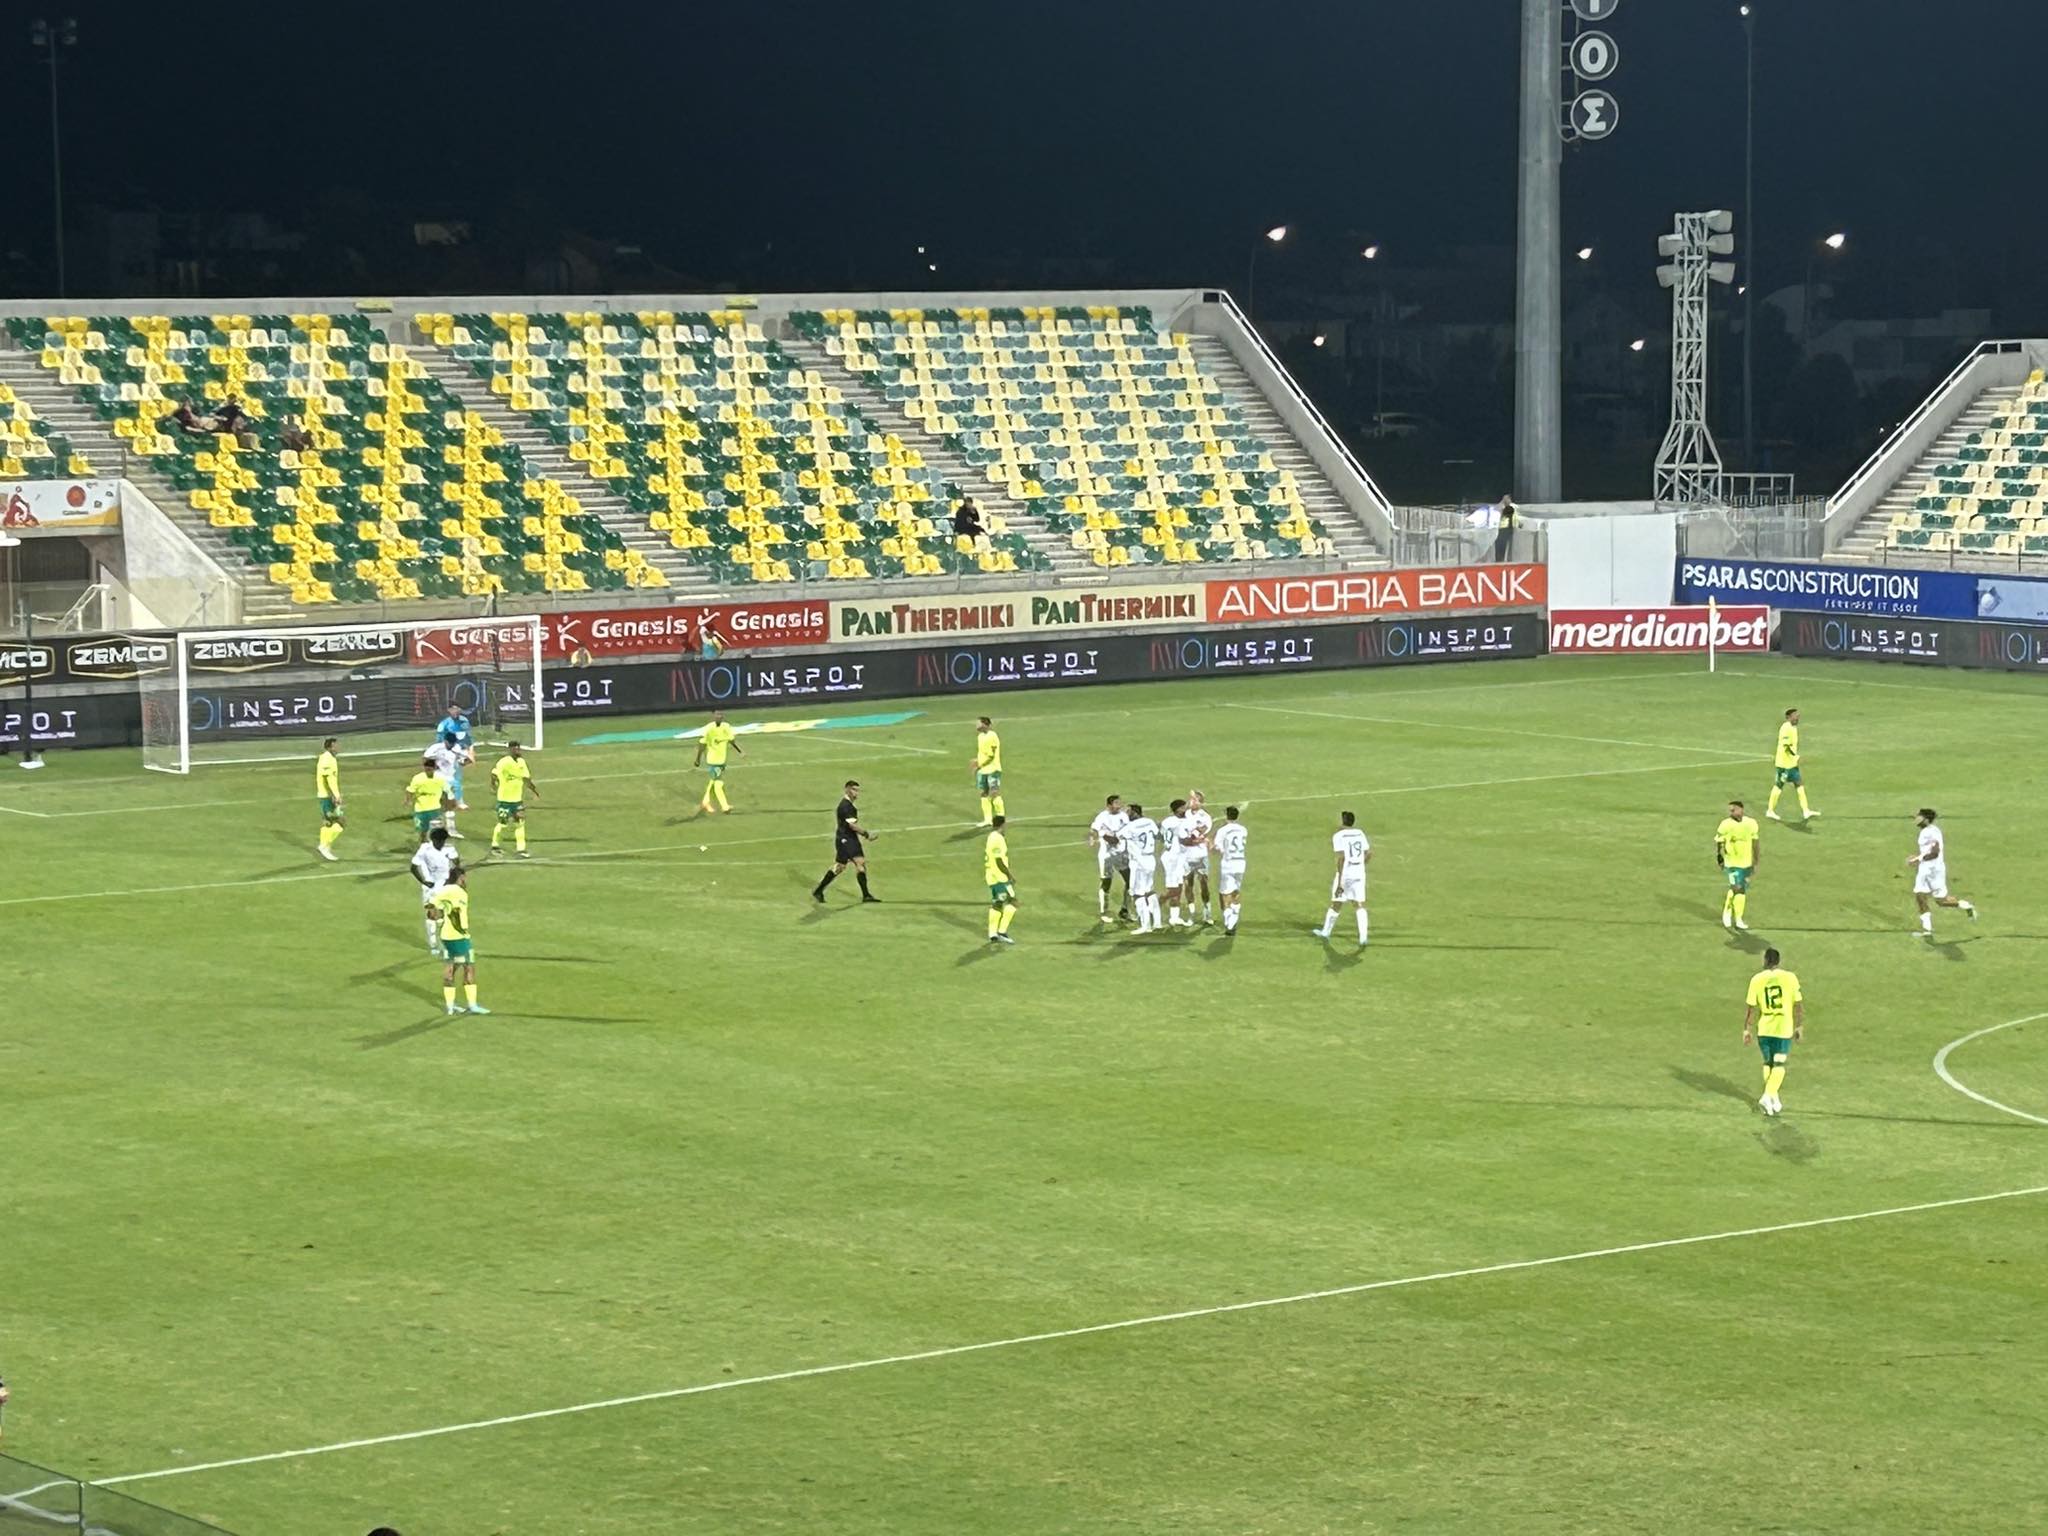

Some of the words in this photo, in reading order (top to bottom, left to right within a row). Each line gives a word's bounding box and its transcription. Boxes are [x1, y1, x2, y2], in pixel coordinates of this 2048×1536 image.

[1217, 575, 1409, 619] ANCORIA
[1419, 568, 1534, 607] BANK
[591, 615, 688, 639] Genesis
[730, 607, 824, 631] Genesis
[1552, 612, 1767, 649] meridianbet
[1418, 625, 1513, 646] INSPOT
[1851, 629, 1939, 649] INSPOT
[74, 645, 168, 666] ZEMCO
[194, 639, 284, 660] ZEMCO
[1215, 637, 1314, 658] INSPOT
[988, 650, 1099, 673] INSPOT
[747, 664, 865, 688] INSPOT
[492, 679, 613, 702] NPOT
[228, 694, 358, 719] INSPOT
[1764, 985, 1783, 1010] 12
